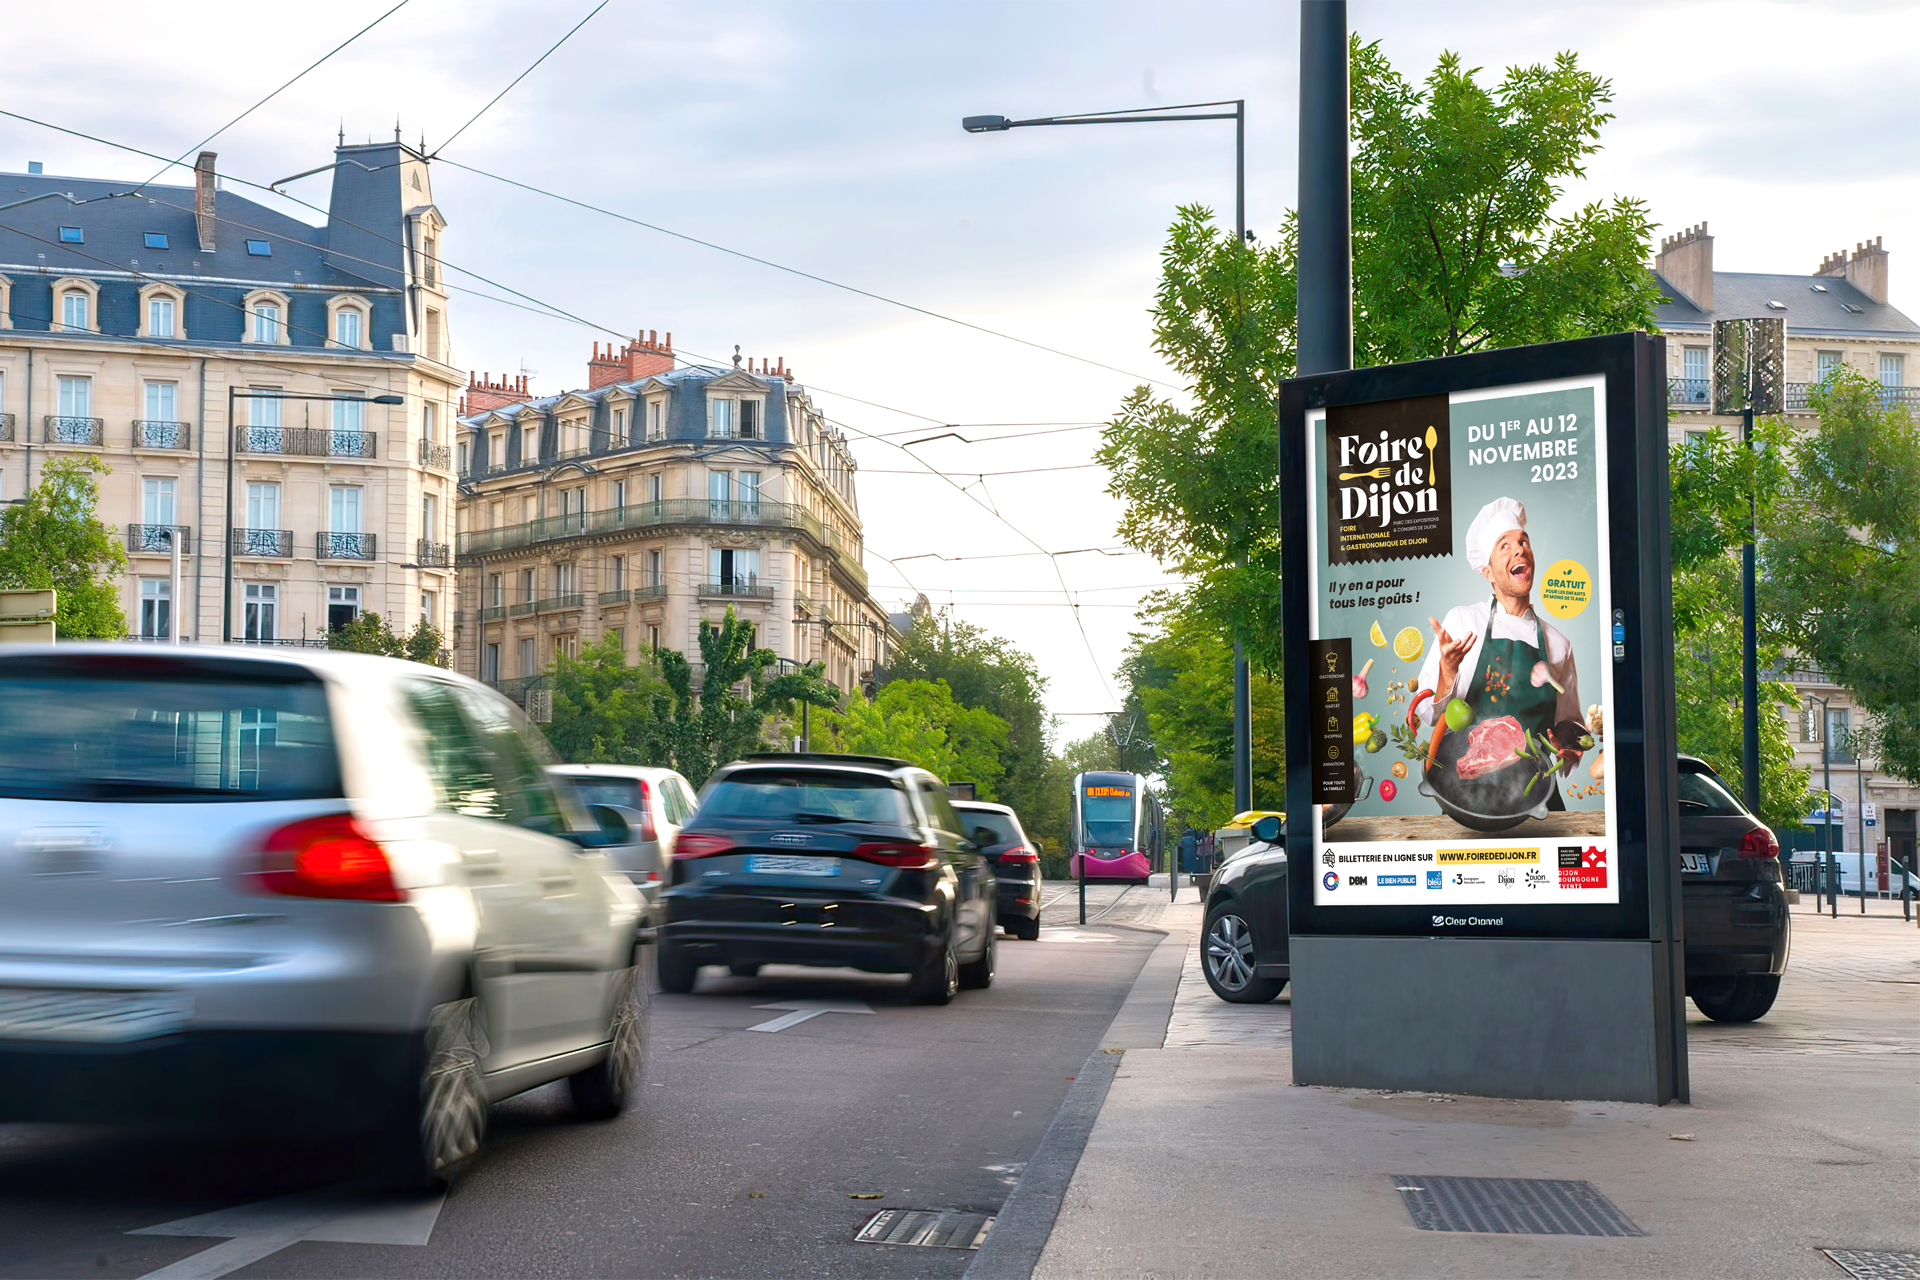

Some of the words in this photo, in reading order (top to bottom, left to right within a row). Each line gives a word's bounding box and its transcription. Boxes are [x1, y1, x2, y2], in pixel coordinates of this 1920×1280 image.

[1468, 423, 1494, 443] DU
[1525, 417, 1553, 436] AU
[1558, 413, 1578, 433] 12
[1338, 430, 1424, 468] Foire
[1469, 438, 1578, 466] NOVEMBRE
[1395, 461, 1424, 487] de
[1530, 461, 1578, 483] 2023
[1339, 481, 1439, 528] Dijon
[1340, 525, 1357, 533] FOIRE
[1340, 531, 1391, 542] INTERNATIONALE
[1346, 540, 1399, 551] GASTRONOMIQUE
[1408, 537, 1428, 546] DIJON
[1329, 581, 1337, 593] Il
[1339, 583, 1347, 596] y
[1348, 582, 1363, 591] en
[1366, 581, 1373, 590] a
[1375, 578, 1405, 593] pour
[1547, 579, 1586, 590] GRATUIT
[1330, 598, 1356, 609] tous
[1358, 596, 1375, 608] les
[1377, 592, 1413, 609] goûts
[1339, 855, 1381, 863] BILLETTERIE
[1383, 854, 1393, 862] EN
[1394, 854, 1416, 862] LIGNE
[1418, 853, 1433, 861] SUR
[1439, 851, 1537, 861] WWW.FOIREDEDIJON.FR
[1349, 876, 1367, 886] DBM
[1498, 874, 1515, 887] Dijon
[1445, 917, 1467, 926] Clear
[1468, 916, 1504, 926] Channel
